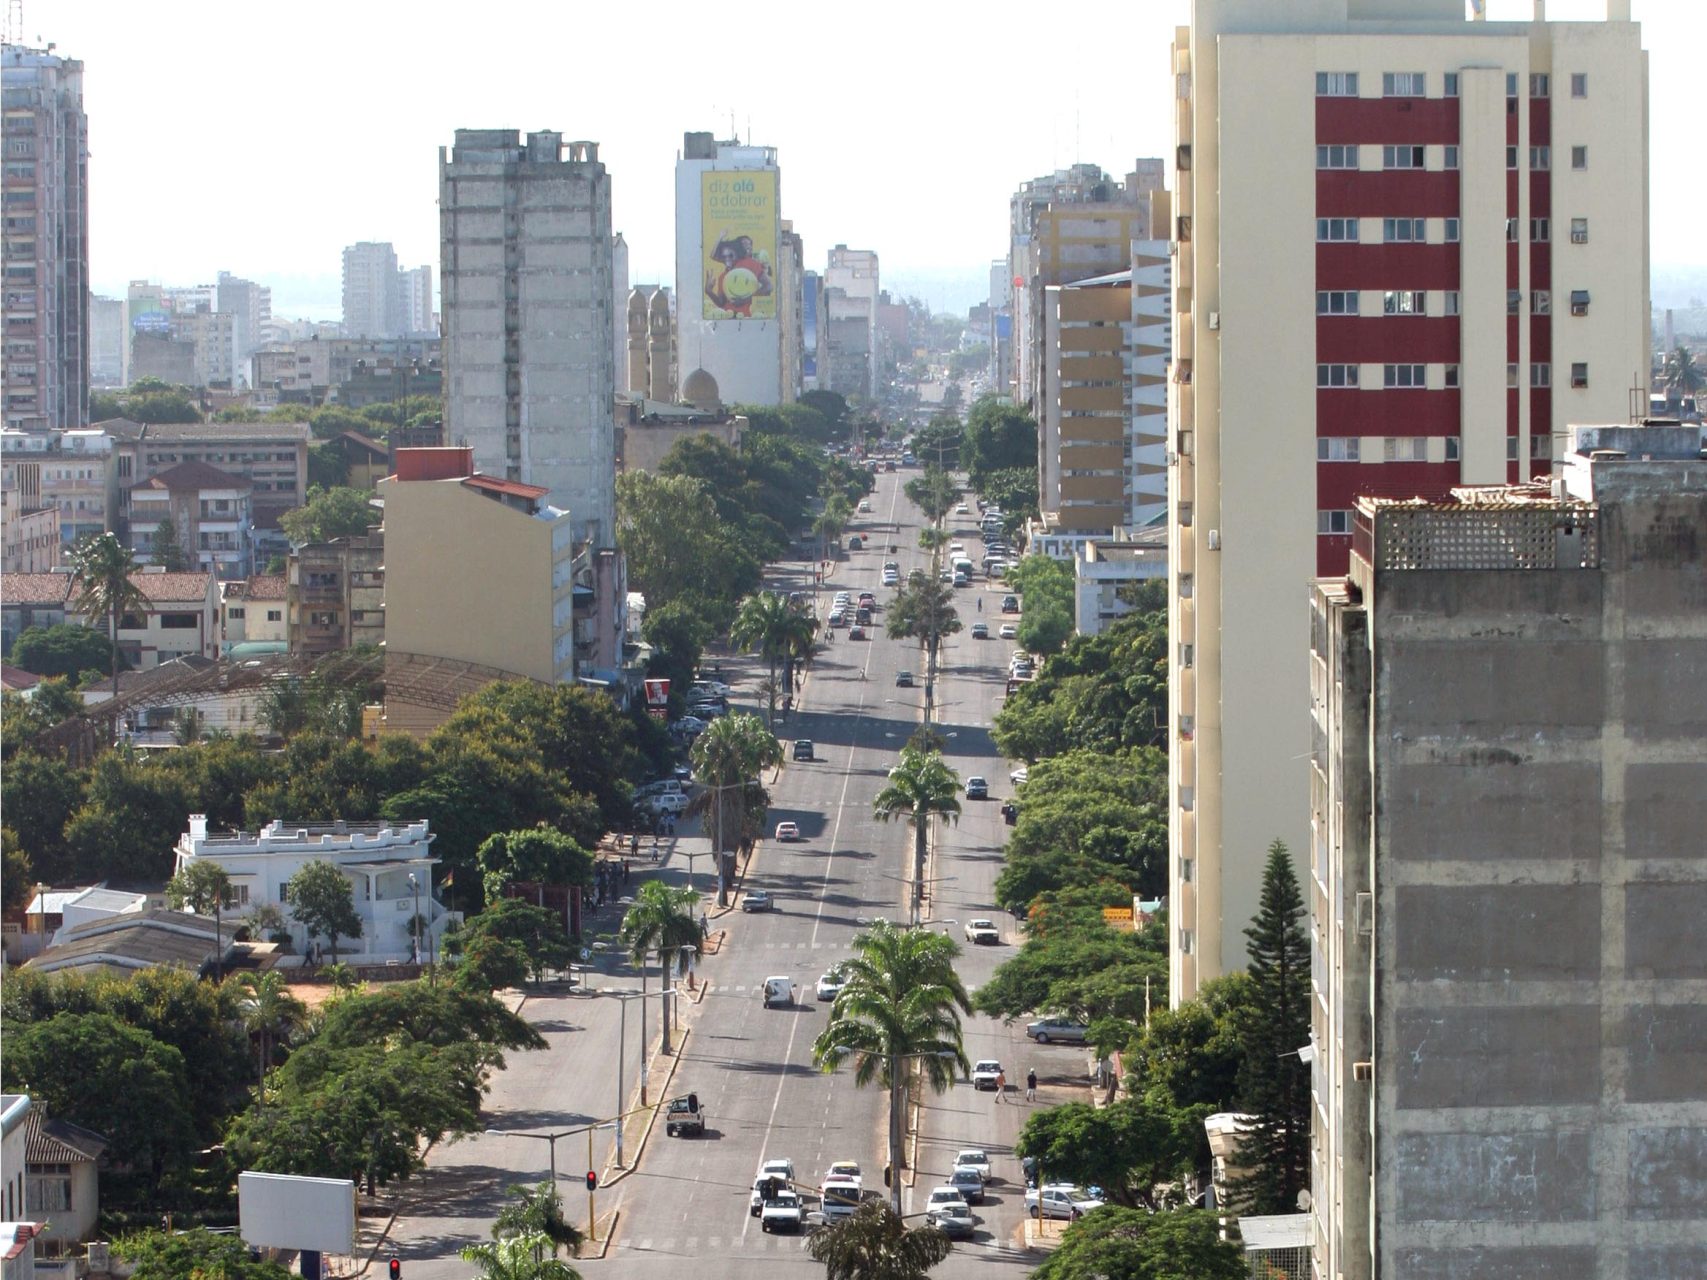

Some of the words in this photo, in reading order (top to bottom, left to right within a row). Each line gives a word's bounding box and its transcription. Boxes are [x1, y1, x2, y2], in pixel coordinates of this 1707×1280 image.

[709, 179, 729, 193] diz
[733, 178, 754, 193] olá
[709, 196, 718, 207] a
[721, 193, 768, 207] dobrar
